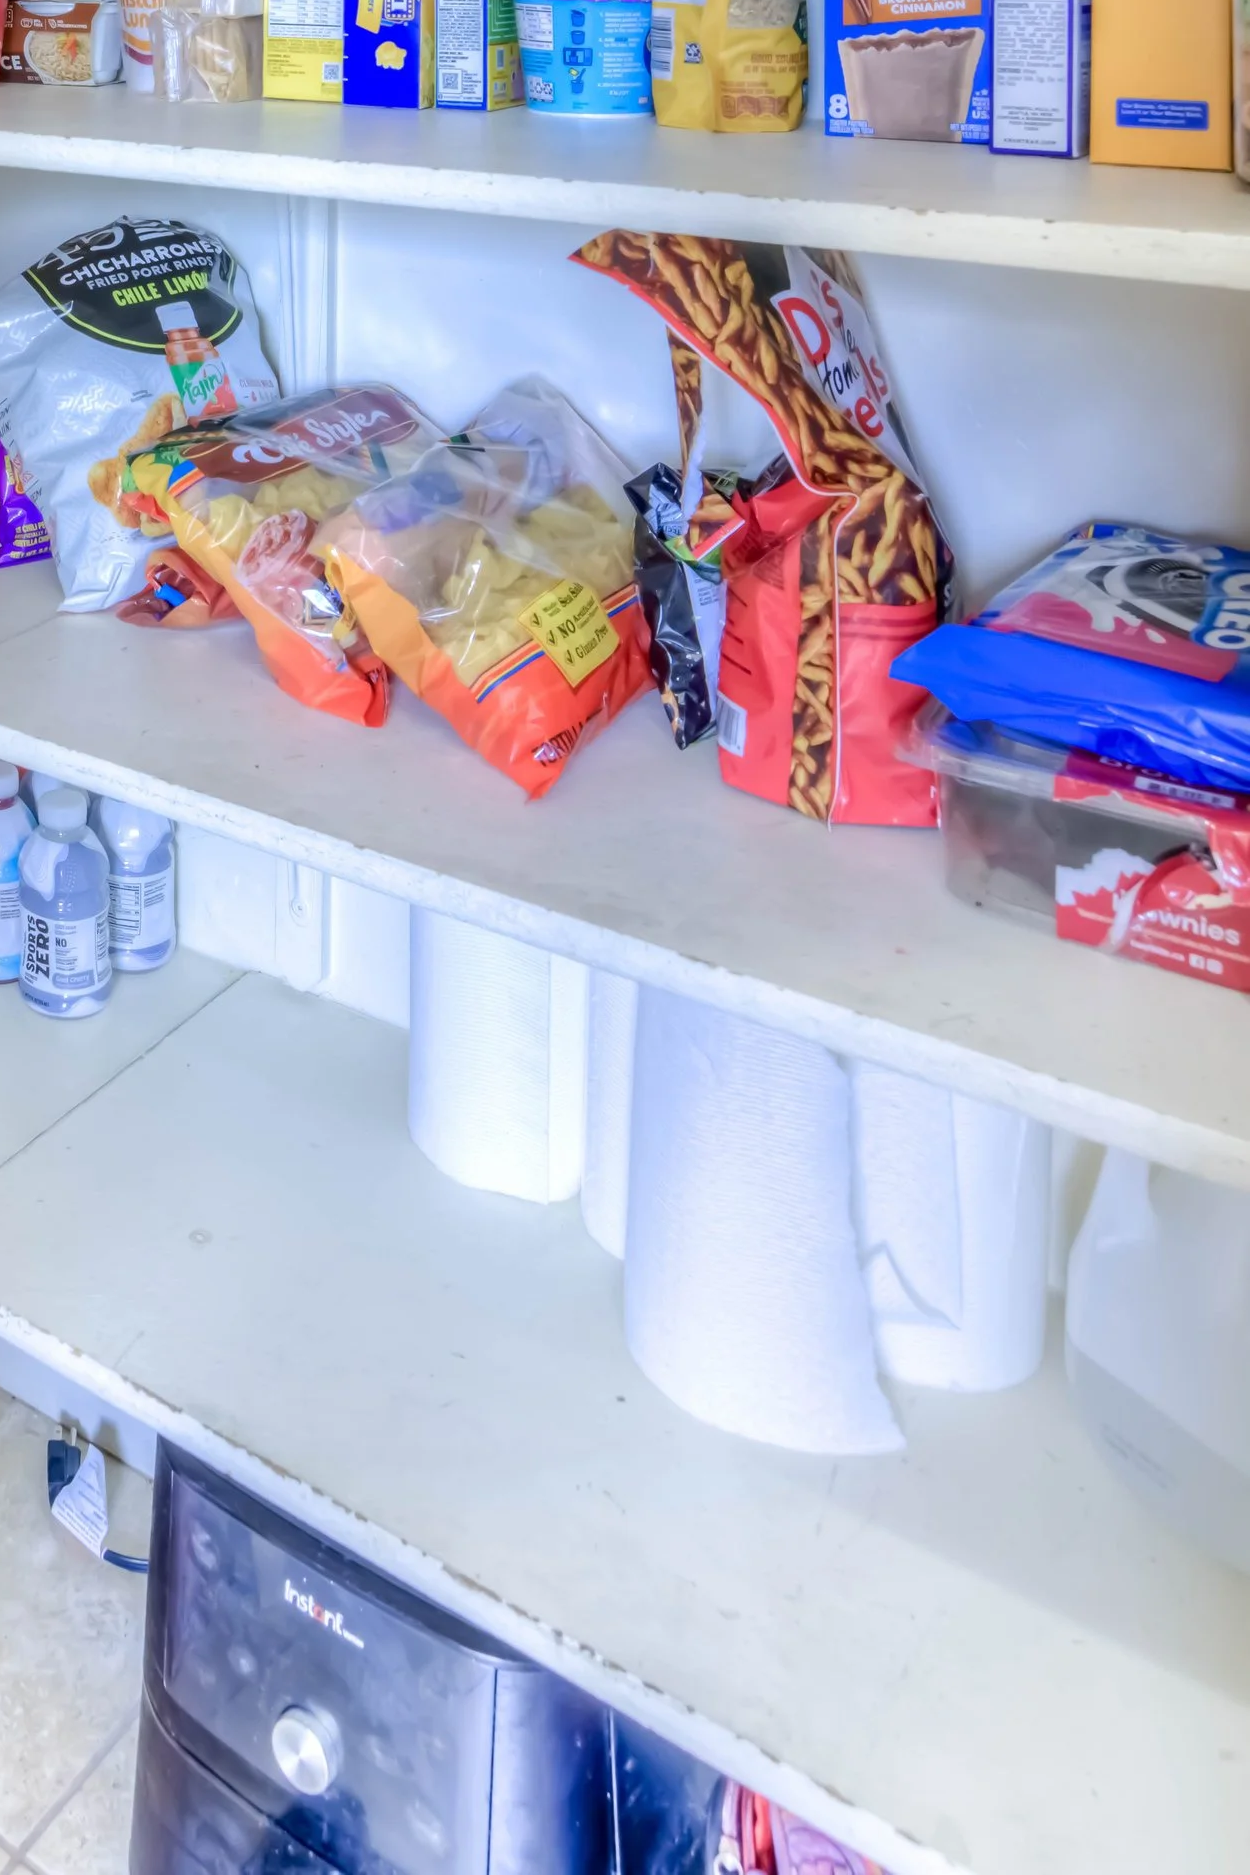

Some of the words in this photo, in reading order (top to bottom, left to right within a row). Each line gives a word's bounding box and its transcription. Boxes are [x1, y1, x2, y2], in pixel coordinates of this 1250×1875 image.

[123, 11, 151, 28] Lun
[890, 0, 966, 15] CINNAMON
[828, 93, 848, 119] 8
[59, 239, 224, 286] CHICHARRONES
[86, 271, 130, 291] FRIED
[132, 264, 172, 281] PORK
[173, 255, 214, 273] RINDS
[111, 282, 162, 307] CHILE
[304, 409, 391, 450] Style
[555, 618, 577, 640] NO
[25, 914, 37, 973] SPORTS
[35, 918, 50, 980] ZERO
[55, 937, 68, 948] NO
[284, 1578, 344, 1636] Instant
